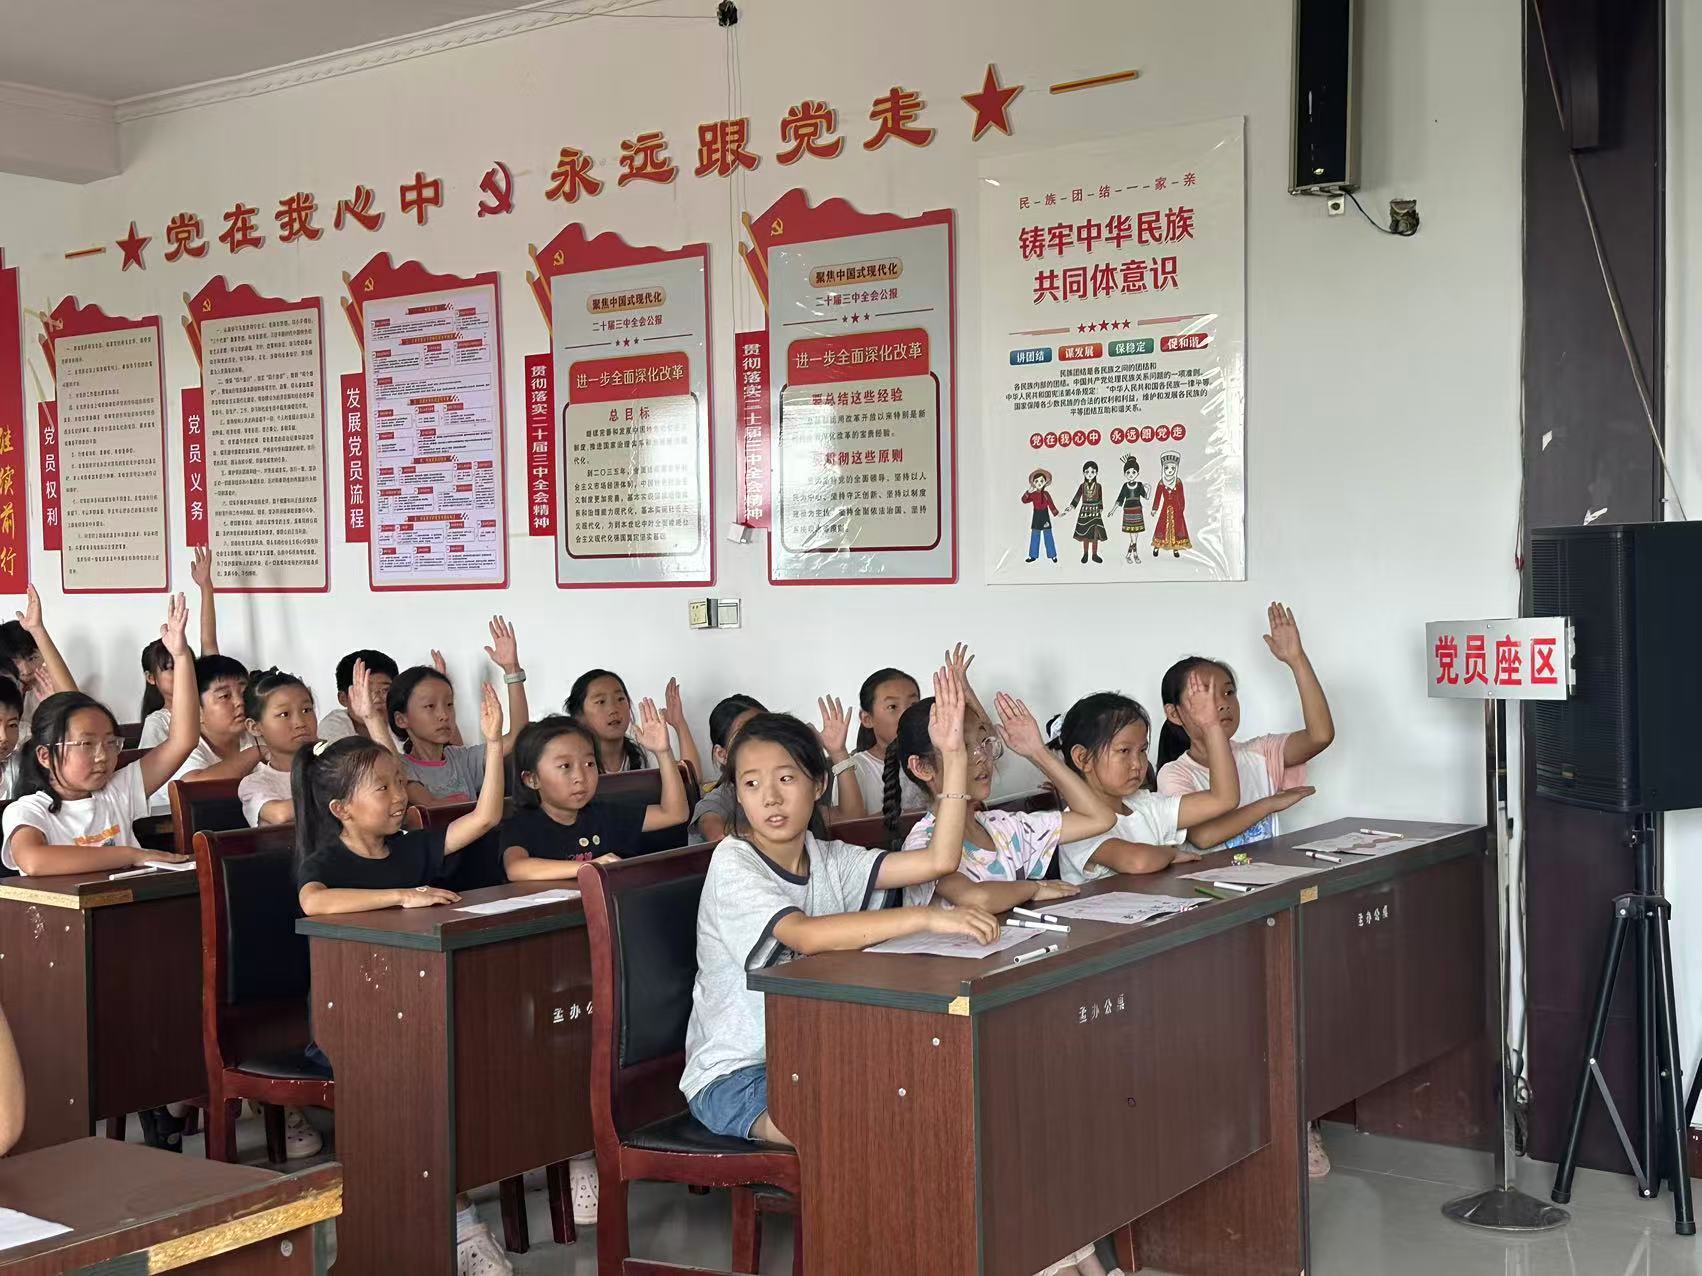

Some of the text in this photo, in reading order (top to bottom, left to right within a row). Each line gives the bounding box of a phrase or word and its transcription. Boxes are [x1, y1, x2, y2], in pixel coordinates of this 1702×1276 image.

[164, 86, 935, 263] 党在我心中 永远跟党走
[1019, 206, 1195, 260] 铸牢中华民族
[816, 262, 898, 284] 聚焦中国式现代化
[1033, 256, 1179, 304] 共同体意识
[592, 291, 662, 310] 聚焦中国式现代化
[816, 288, 898, 307] 二十届三中全会公报
[592, 314, 663, 331] 二十届三中全会公报
[795, 342, 923, 369] 进一步全面深化改革
[1115, 341, 1146, 355] 保稳定
[576, 364, 684, 389] 进一步全面深化改革
[609, 406, 650, 422] 总目标
[531, 365, 550, 528] 贯彻落实二十届三中全会精神
[1030, 430, 1100, 448] 党在我心中
[188, 414, 204, 521] 党员义务
[346, 388, 365, 529] 发展党员流程
[43, 425, 58, 527] 党员权利
[1435, 634, 1558, 685] 党员座区
